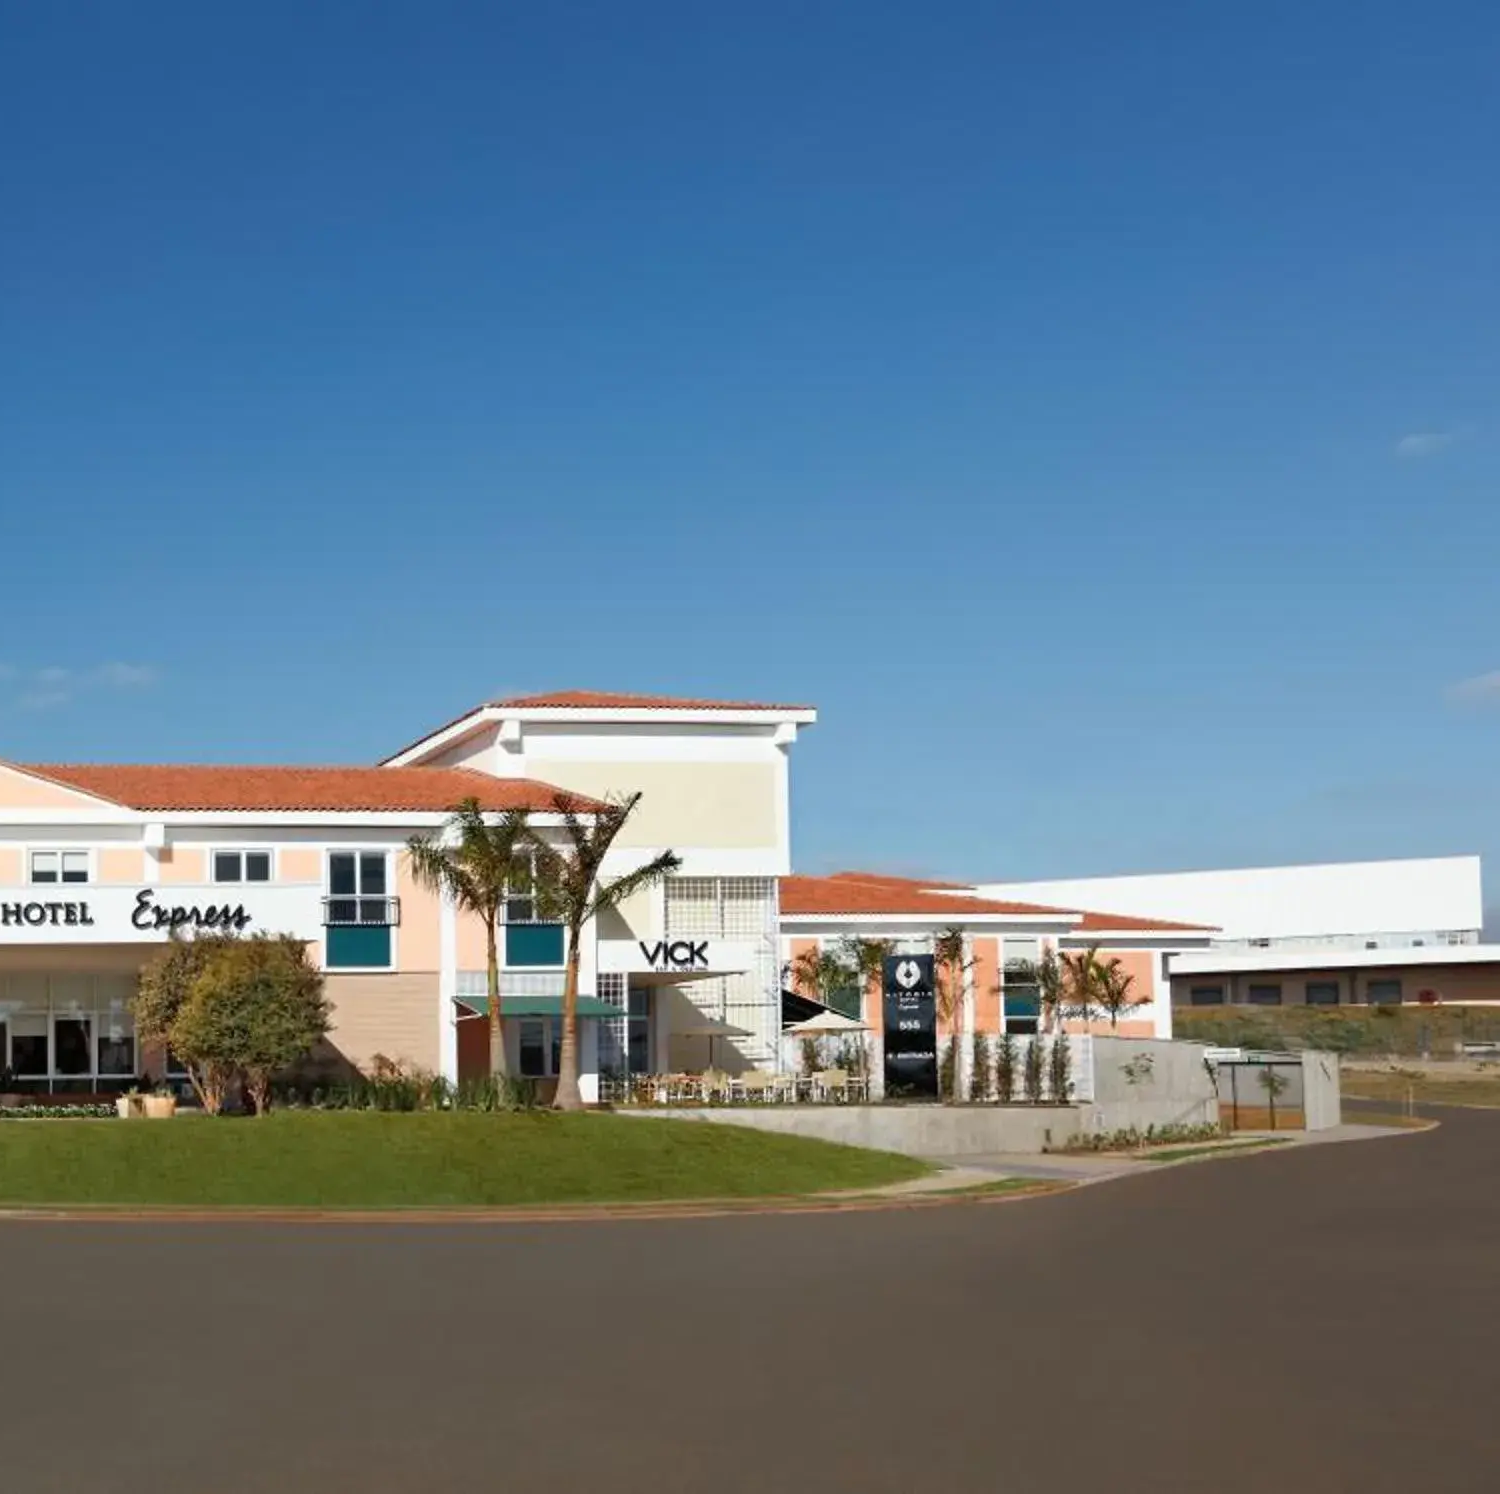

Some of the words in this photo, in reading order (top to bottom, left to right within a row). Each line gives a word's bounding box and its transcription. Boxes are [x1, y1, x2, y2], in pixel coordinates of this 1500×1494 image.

[0, 901, 95, 926] HOTEL
[130, 888, 252, 933] Express
[639, 941, 709, 966] VICK
